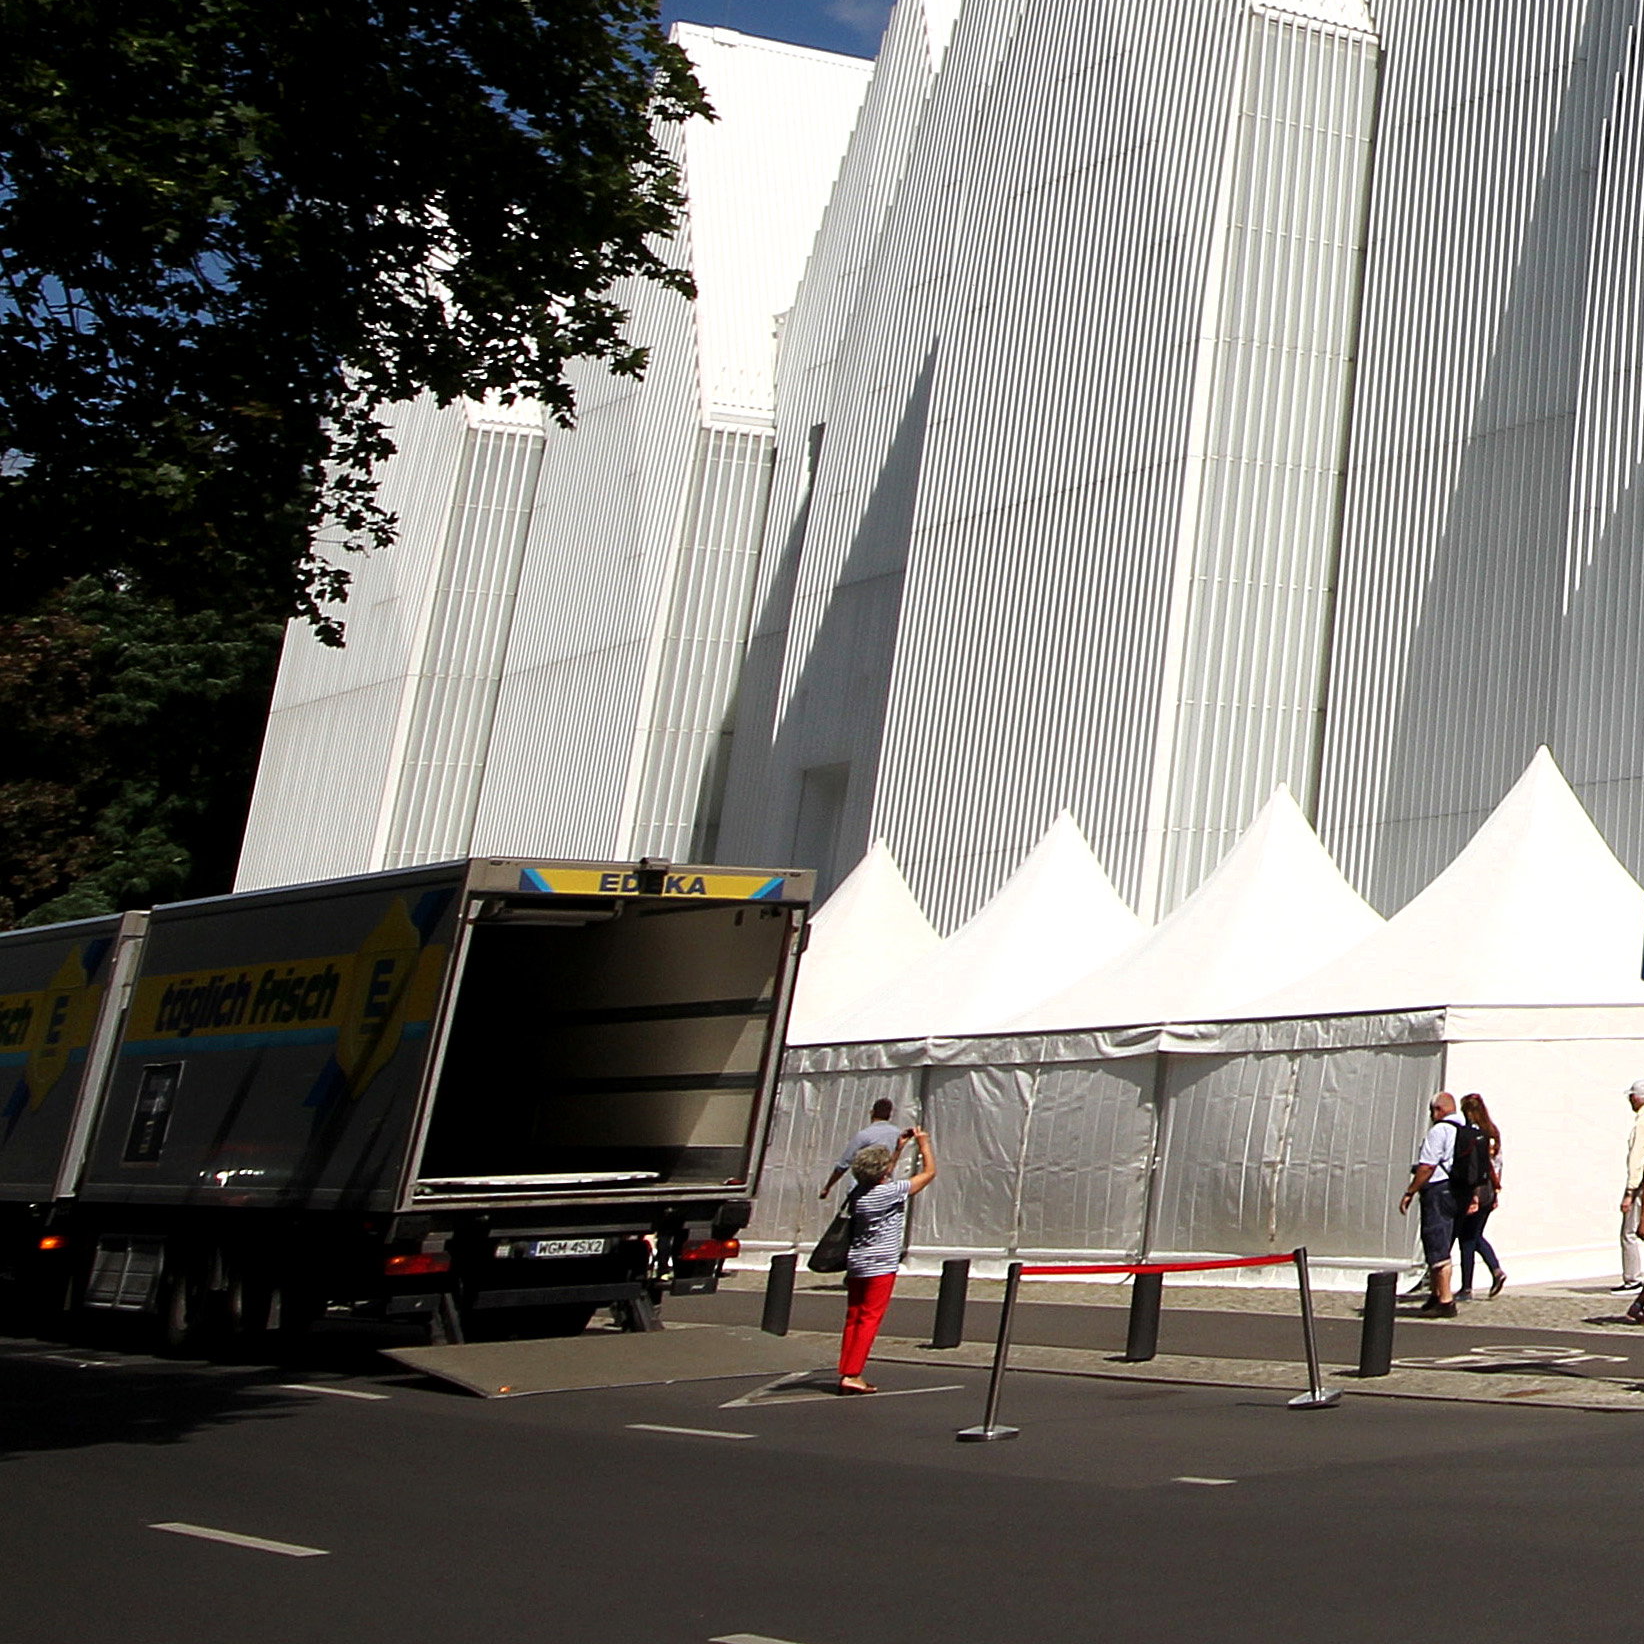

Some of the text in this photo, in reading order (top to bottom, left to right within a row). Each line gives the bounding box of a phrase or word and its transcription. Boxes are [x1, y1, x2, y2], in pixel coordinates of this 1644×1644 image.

[598, 872, 707, 896] EDKA
[154, 962, 341, 1037] täglich frisch
[538, 1242, 568, 1255] WGM
